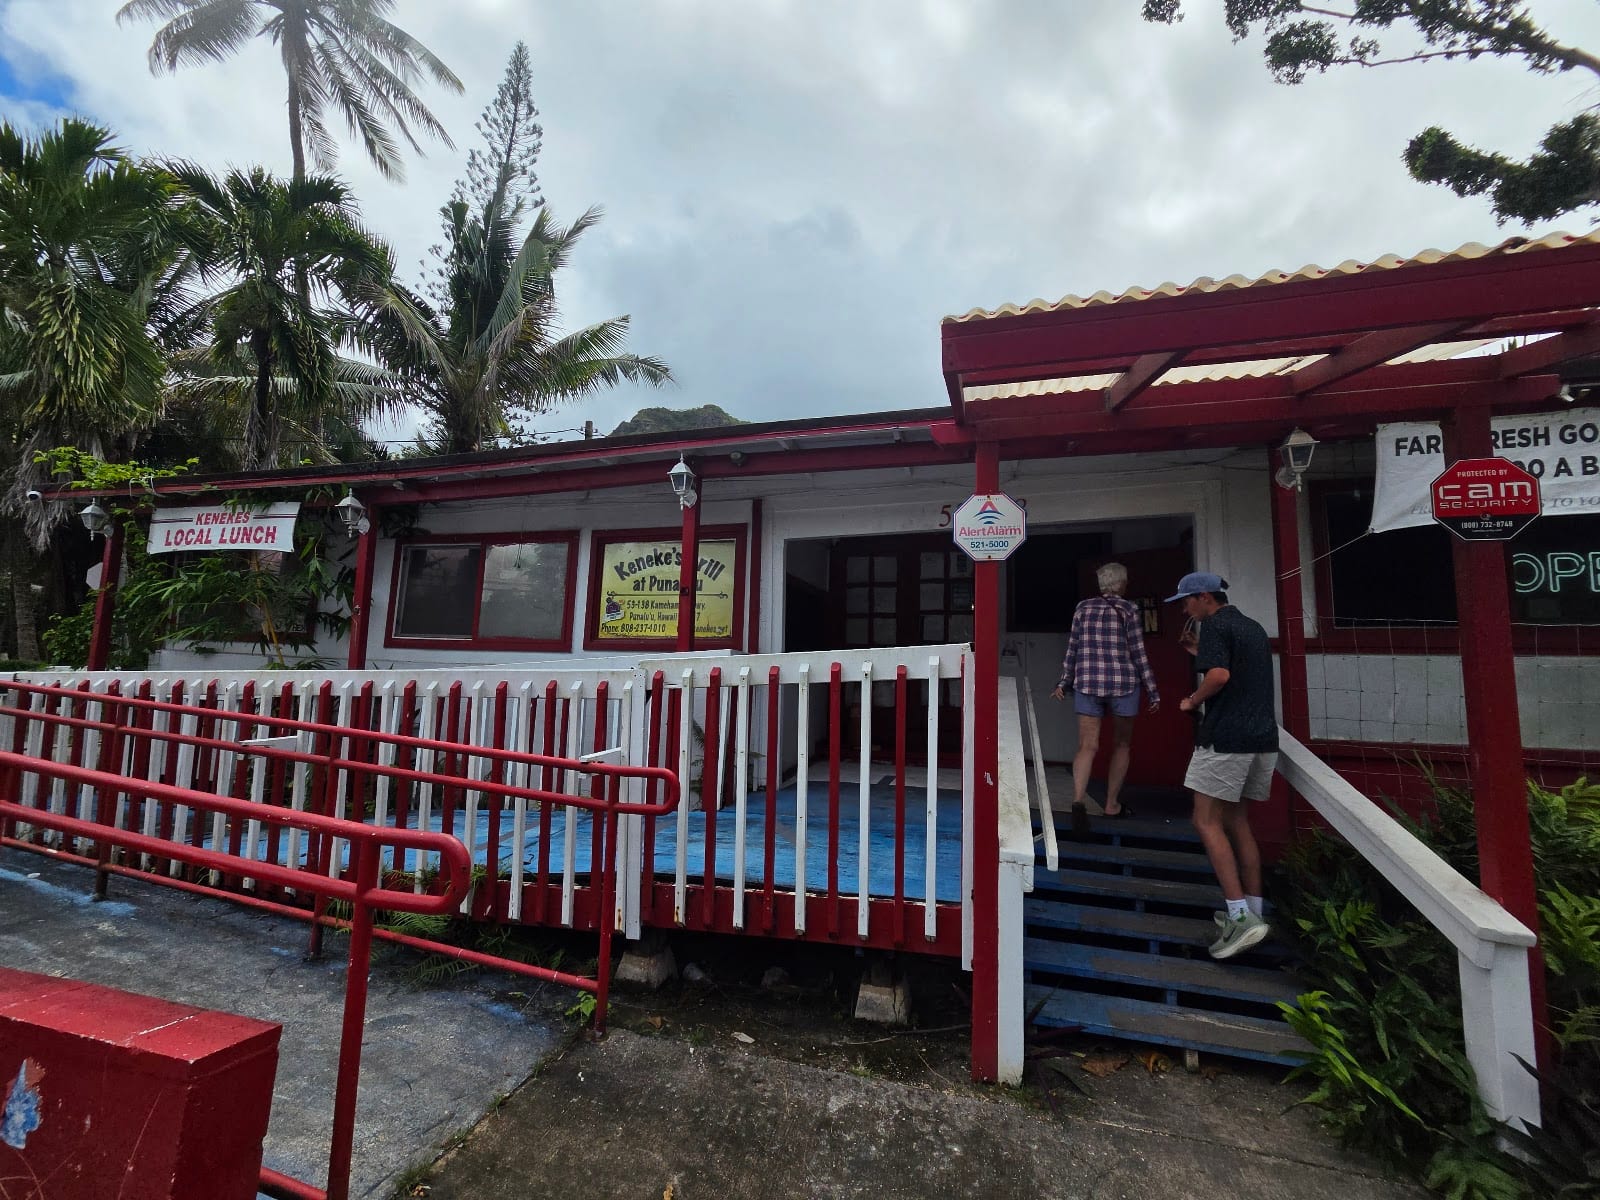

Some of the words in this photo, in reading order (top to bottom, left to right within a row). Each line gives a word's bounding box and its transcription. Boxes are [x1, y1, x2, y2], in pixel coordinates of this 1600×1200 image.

[1395, 434, 1441, 456] FAR
[1490, 426, 1550, 449] RESH
[1559, 422, 1600, 444] GO
[1553, 457, 1573, 477] A
[1581, 455, 1600, 475] B
[1457, 470, 1497, 478] PROTECTED
[195, 511, 250, 525] KENEKES
[164, 528, 212, 546] LOCAL
[218, 526, 277, 544] LUNCH
[970, 540, 1009, 549] 521-5000
[614, 547, 682, 581] Keneke's
[697, 558, 725, 581] rill
[632, 576, 645, 591] at
[626, 600, 650, 609] 53-138
